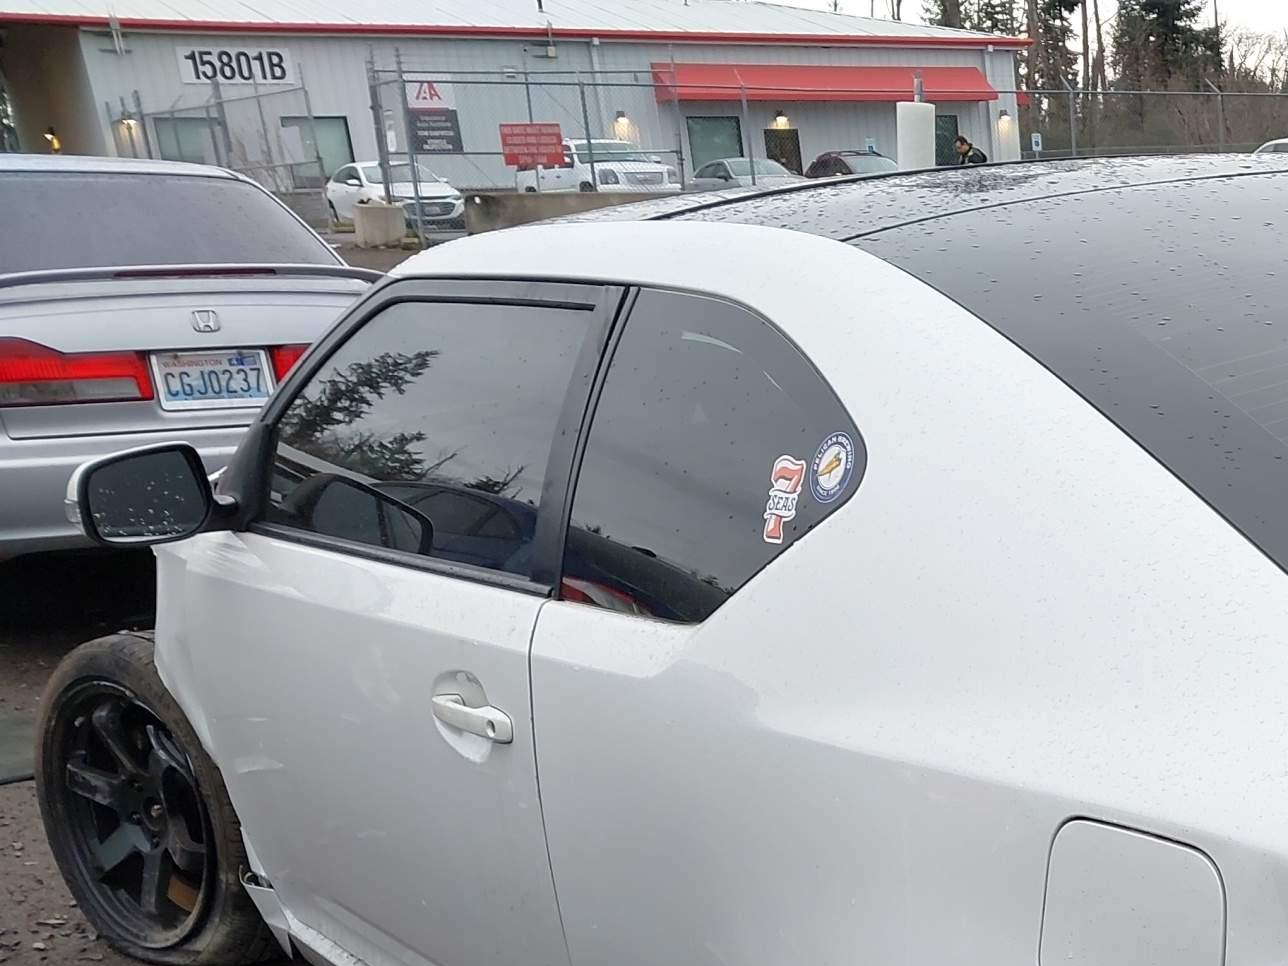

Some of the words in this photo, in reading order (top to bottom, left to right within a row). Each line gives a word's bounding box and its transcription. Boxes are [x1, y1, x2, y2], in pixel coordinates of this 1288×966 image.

[183, 50, 287, 80] 15801B
[415, 81, 442, 100] IAA
[161, 359, 224, 369] WASHINGTON
[164, 367, 262, 397] CGJ0237
[813, 436, 837, 470] PELICAN
[837, 435, 852, 469] BREWING
[768, 495, 797, 511] SEAS
